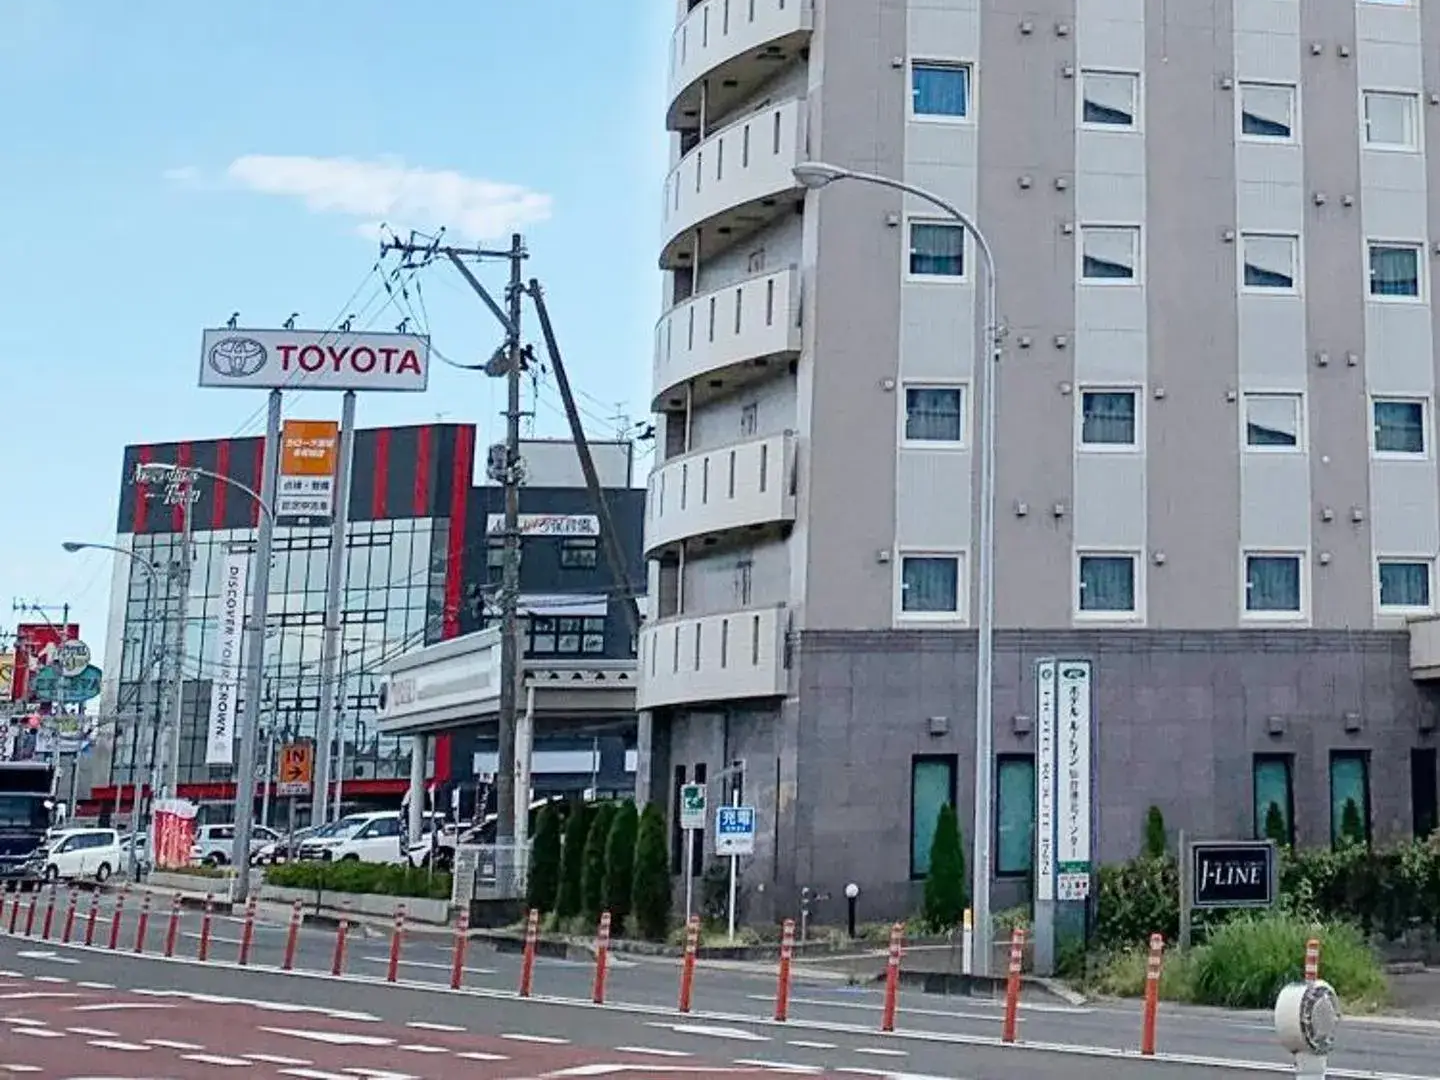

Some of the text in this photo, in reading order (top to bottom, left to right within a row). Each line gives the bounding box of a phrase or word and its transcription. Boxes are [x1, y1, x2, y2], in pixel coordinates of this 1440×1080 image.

[276, 345, 421, 375] TOYOTA
[225, 565, 239, 635] DISCOVER
[285, 749, 305, 764] IN
